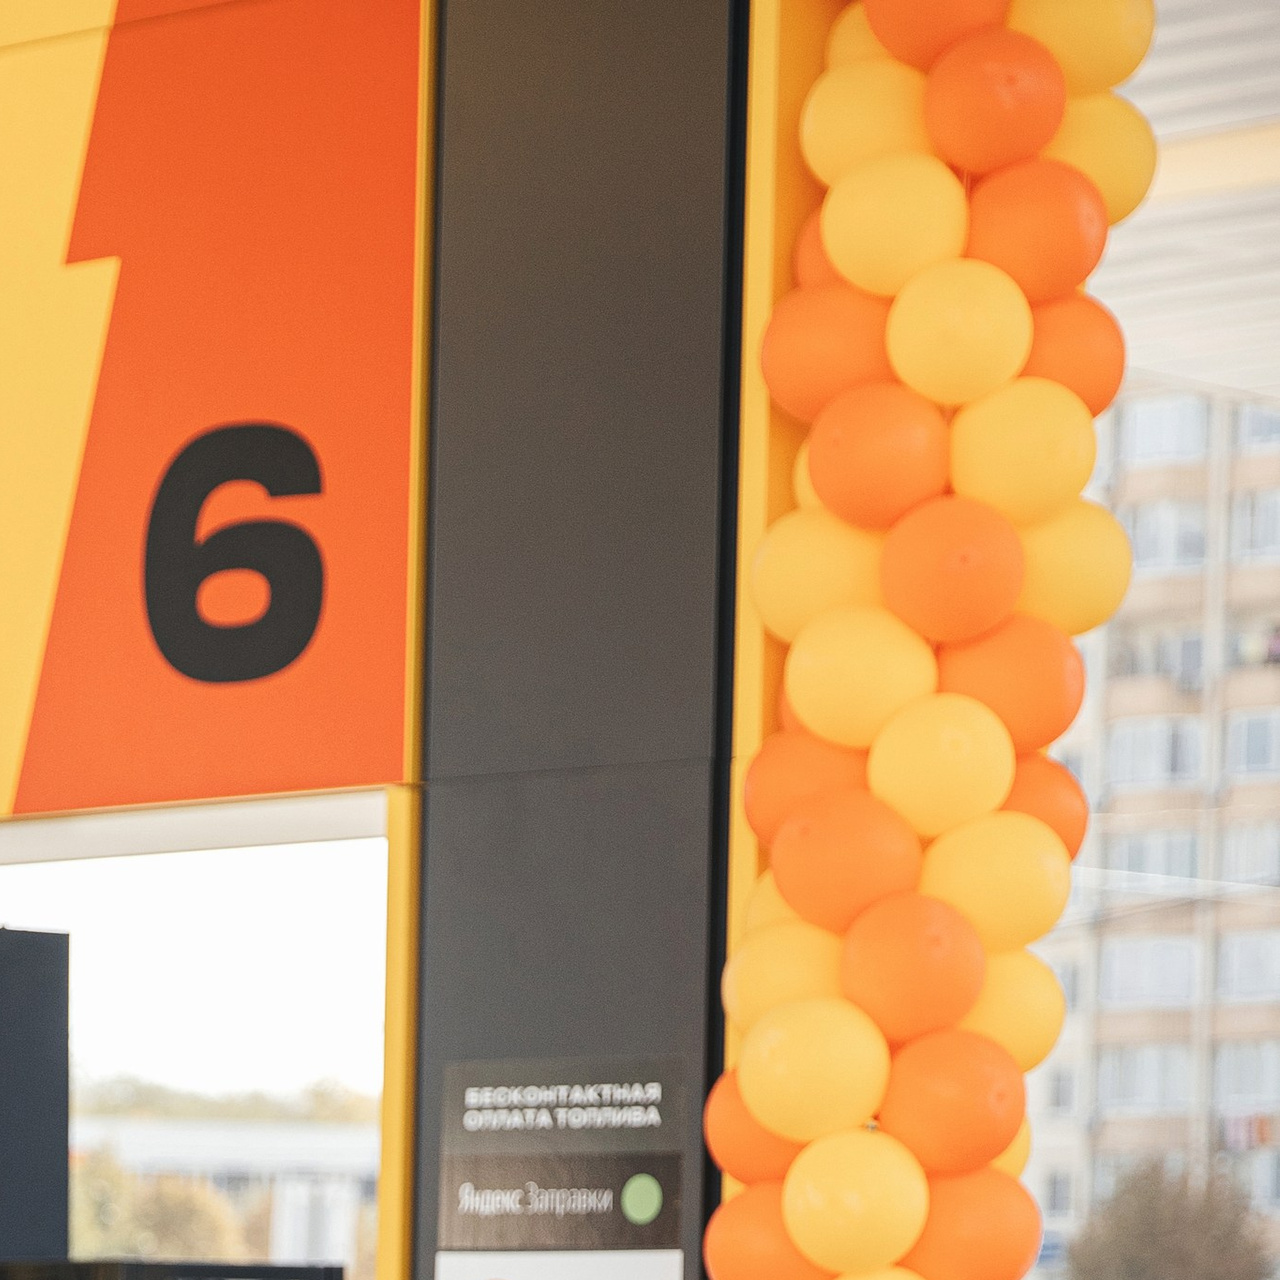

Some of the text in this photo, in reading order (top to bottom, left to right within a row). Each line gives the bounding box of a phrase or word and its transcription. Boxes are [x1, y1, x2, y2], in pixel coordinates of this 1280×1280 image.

[142, 420, 327, 684] 6
[464, 1081, 663, 1109] БЕСКОНТАКТНАЯ
[463, 1105, 662, 1132] ОПЛАТА ТОПЛИВА
